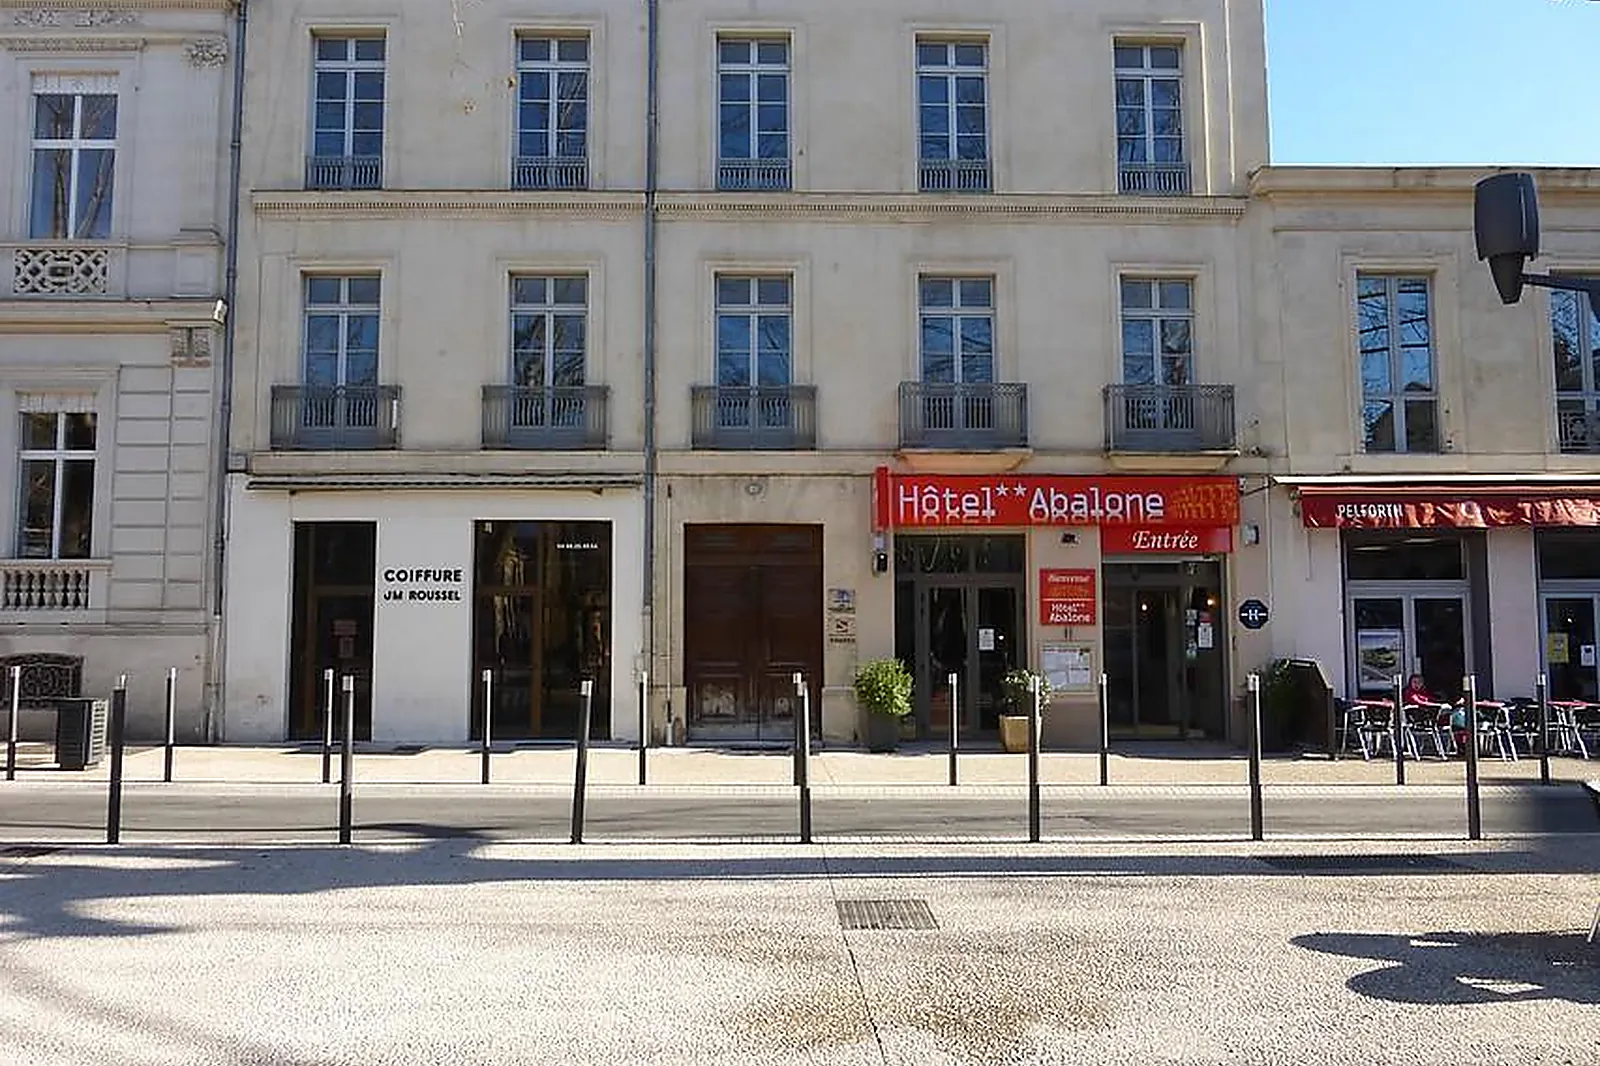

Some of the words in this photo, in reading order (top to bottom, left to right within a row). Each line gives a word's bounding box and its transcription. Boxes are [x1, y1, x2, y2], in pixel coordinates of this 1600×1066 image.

[1029, 486, 1165, 520] Abalone
[1132, 529, 1198, 549] Entrée
[384, 569, 462, 582] COIFFURE
[383, 590, 403, 601] JM
[409, 590, 461, 601] ROUSSEL
[1050, 613, 1090, 622] Abalone
